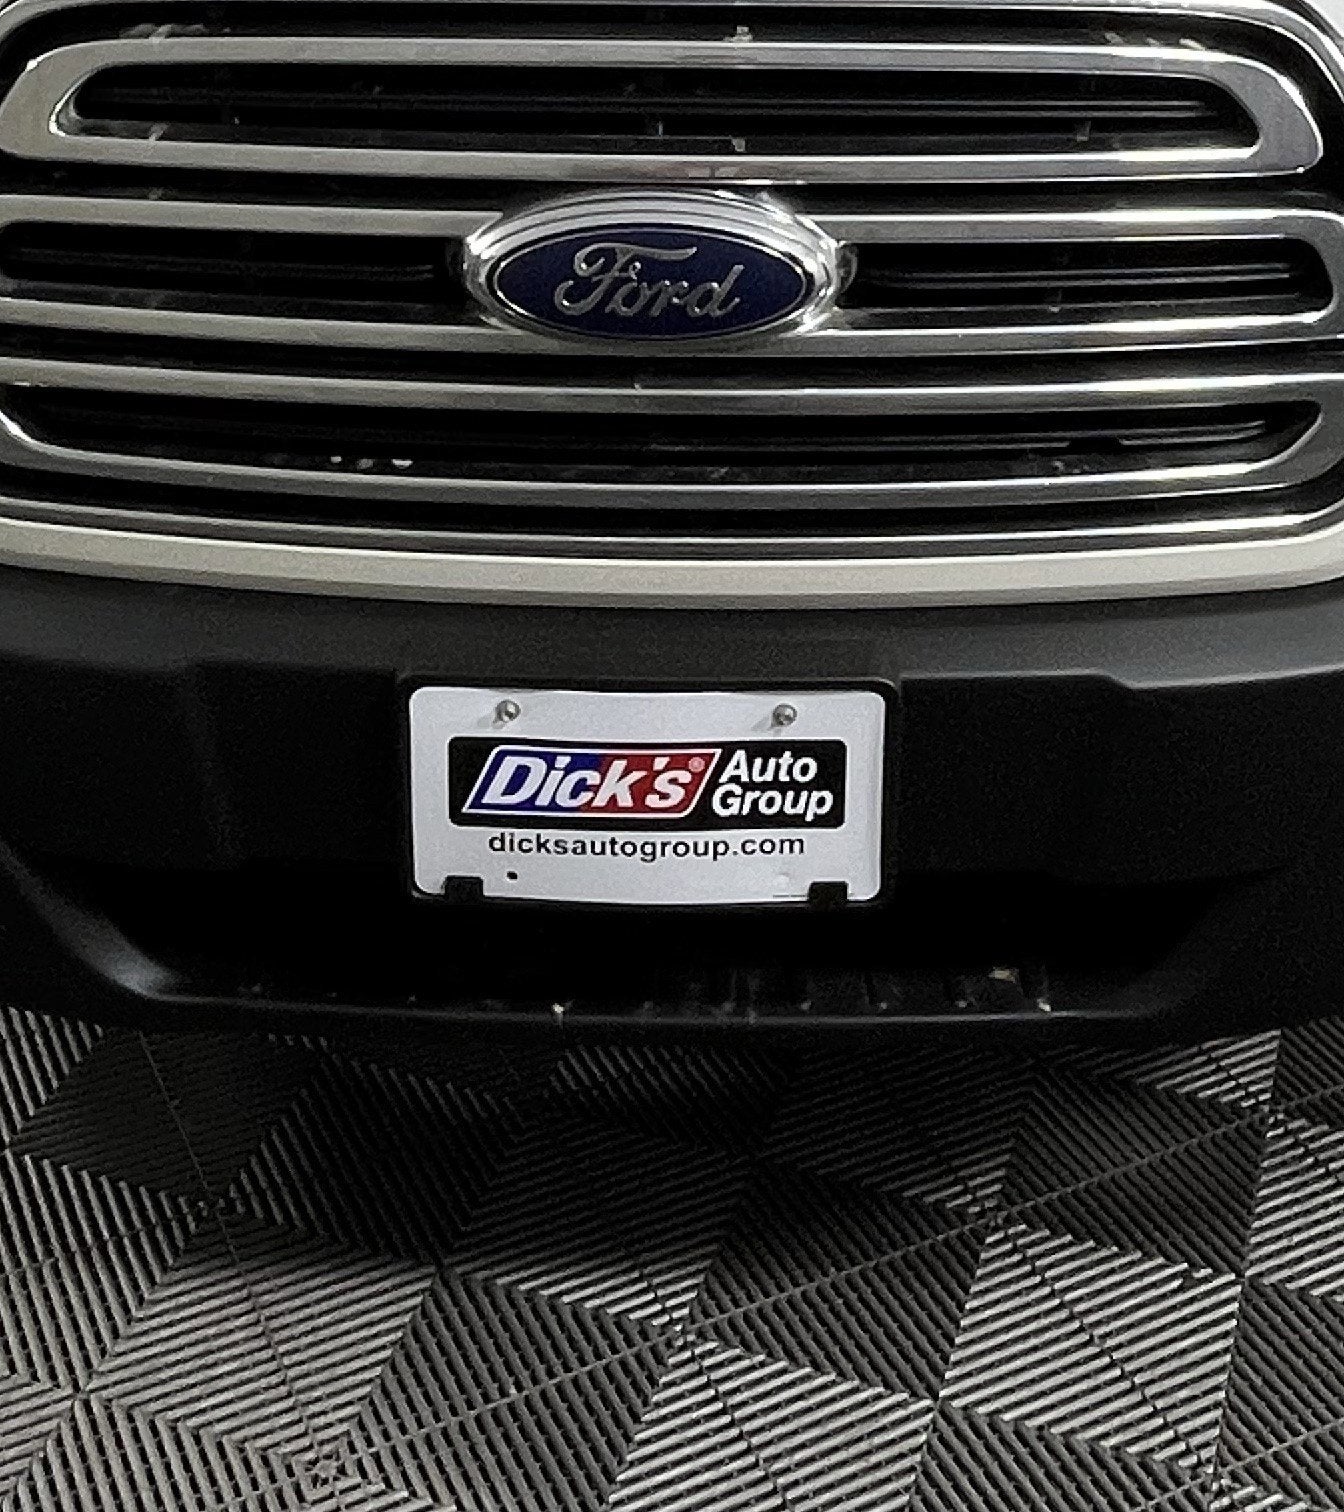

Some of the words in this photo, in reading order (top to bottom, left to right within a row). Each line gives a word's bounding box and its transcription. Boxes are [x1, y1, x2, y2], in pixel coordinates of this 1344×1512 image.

[554, 242, 744, 318] Ford
[479, 754, 693, 809] Dick's
[718, 749, 818, 784] Auto
[711, 785, 835, 822] Group
[487, 832, 805, 863] dicksautogroup.com
